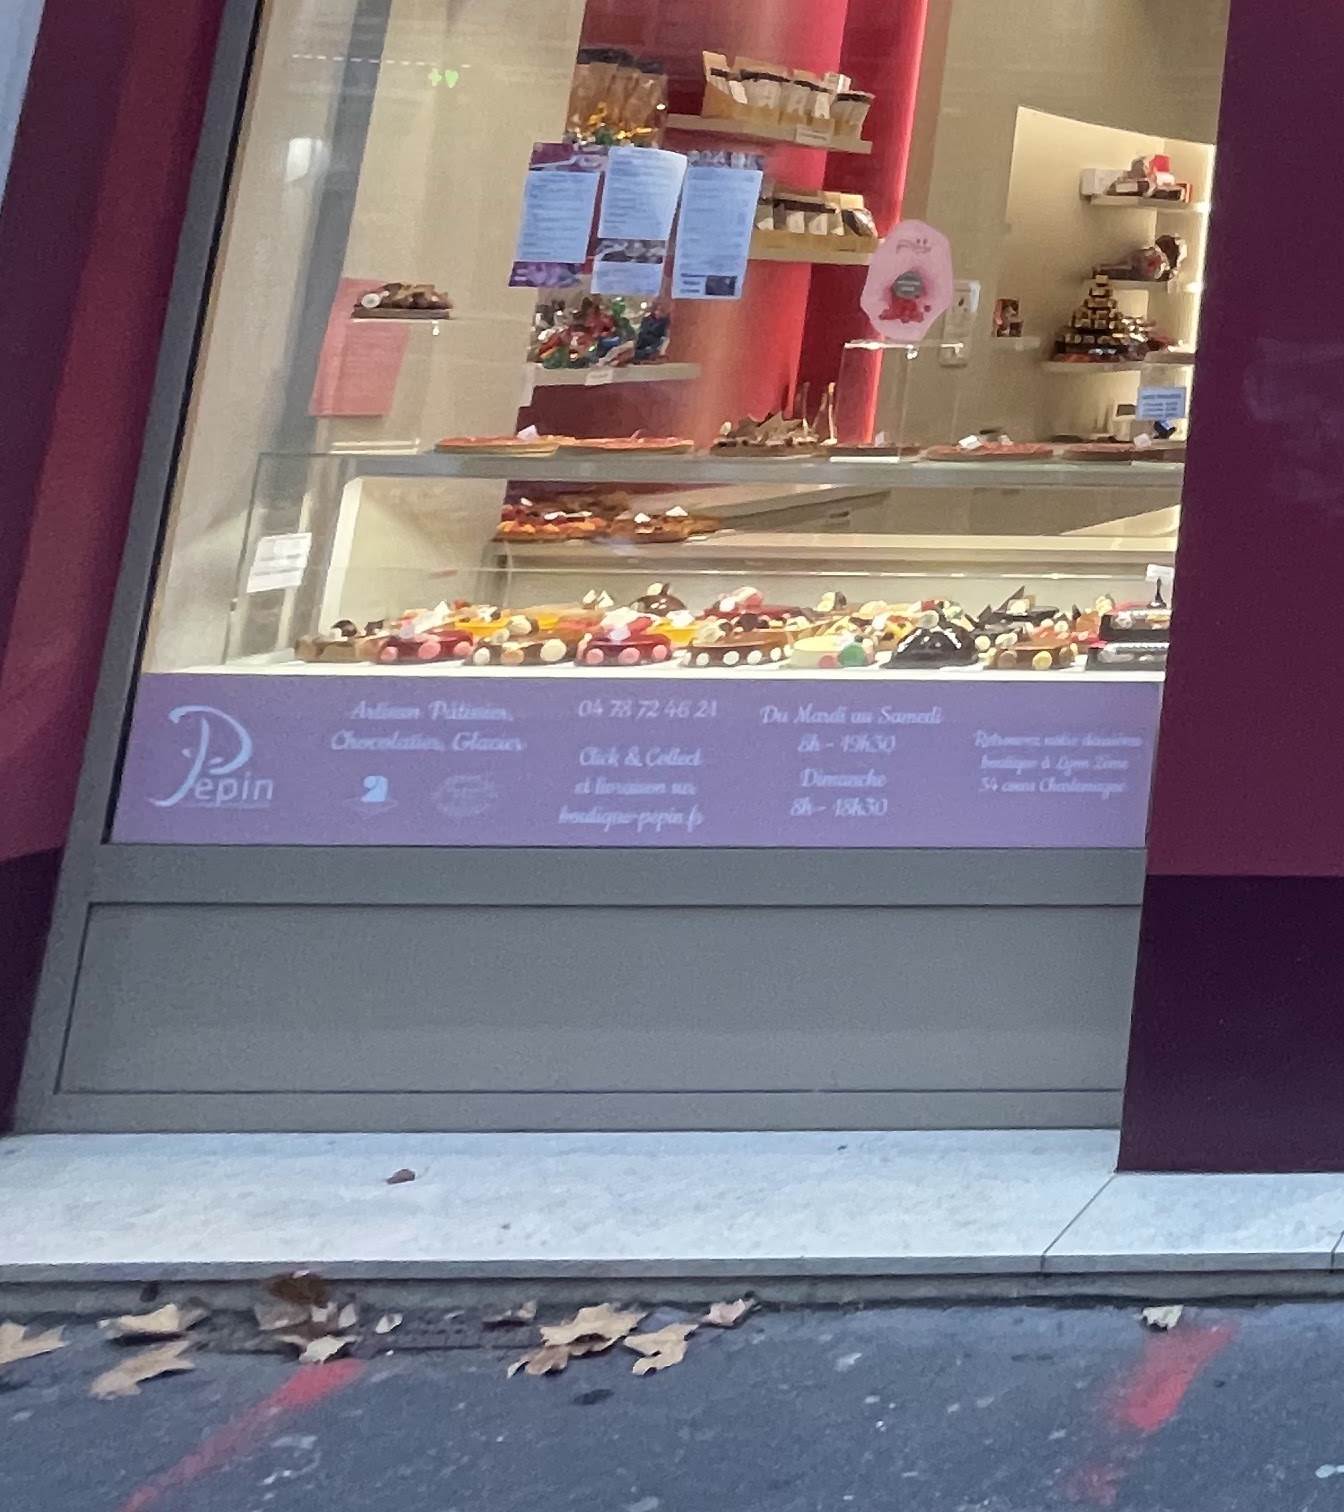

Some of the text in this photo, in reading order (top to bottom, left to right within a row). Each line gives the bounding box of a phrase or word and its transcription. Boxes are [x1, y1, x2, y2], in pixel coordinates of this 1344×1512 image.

[579, 700, 602, 718] 04
[635, 699, 659, 720] 72
[694, 699, 718, 718] 21
[761, 705, 788, 724] Du
[793, 704, 846, 725] Mardi
[878, 704, 943, 725] Samedi
[624, 747, 643, 767] &
[801, 769, 887, 789] Dimanche
